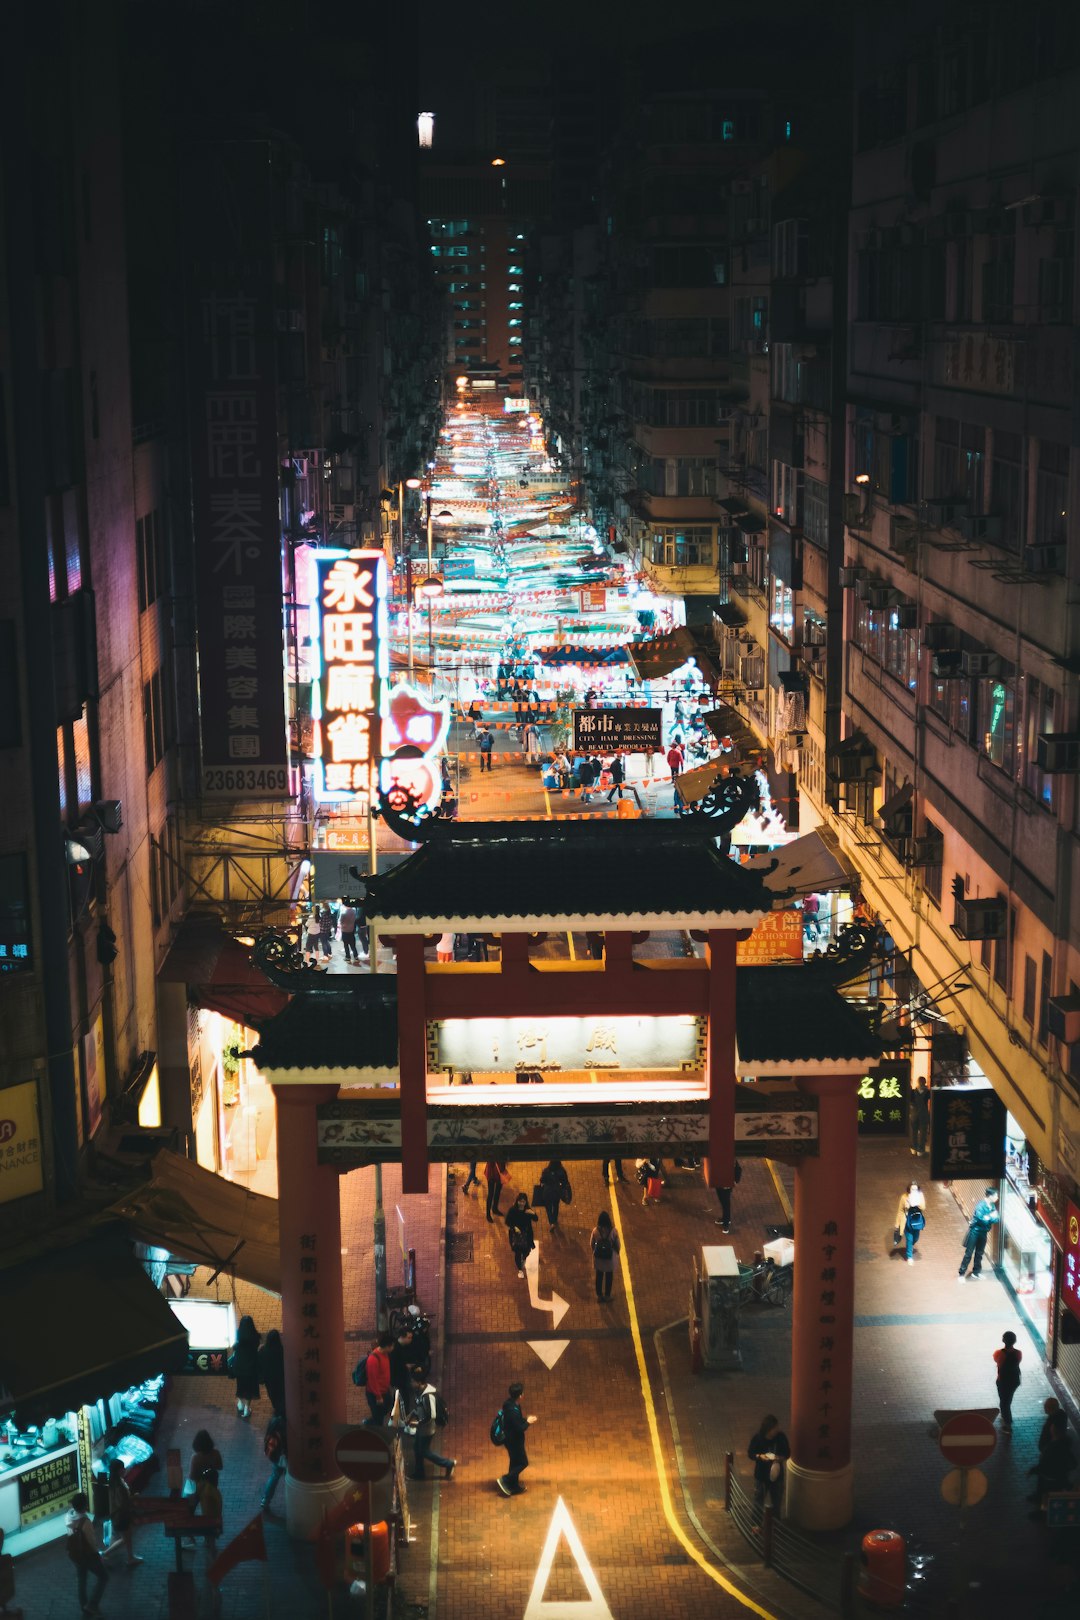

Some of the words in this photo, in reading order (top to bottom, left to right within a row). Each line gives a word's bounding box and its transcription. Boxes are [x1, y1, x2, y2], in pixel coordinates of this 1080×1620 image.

[222, 586, 259, 759] 國際美容集團
[579, 714, 615, 733] 都市
[205, 771, 286, 792] 23683469
[749, 932, 764, 940] NG
[766, 932, 800, 940] HOSTEL
[20, 1456, 70, 1483] WESTERN
[37, 1464, 71, 1484] UNION
[22, 1497, 45, 1511] MONEY
[45, 1483, 77, 1501] TRANSFER
